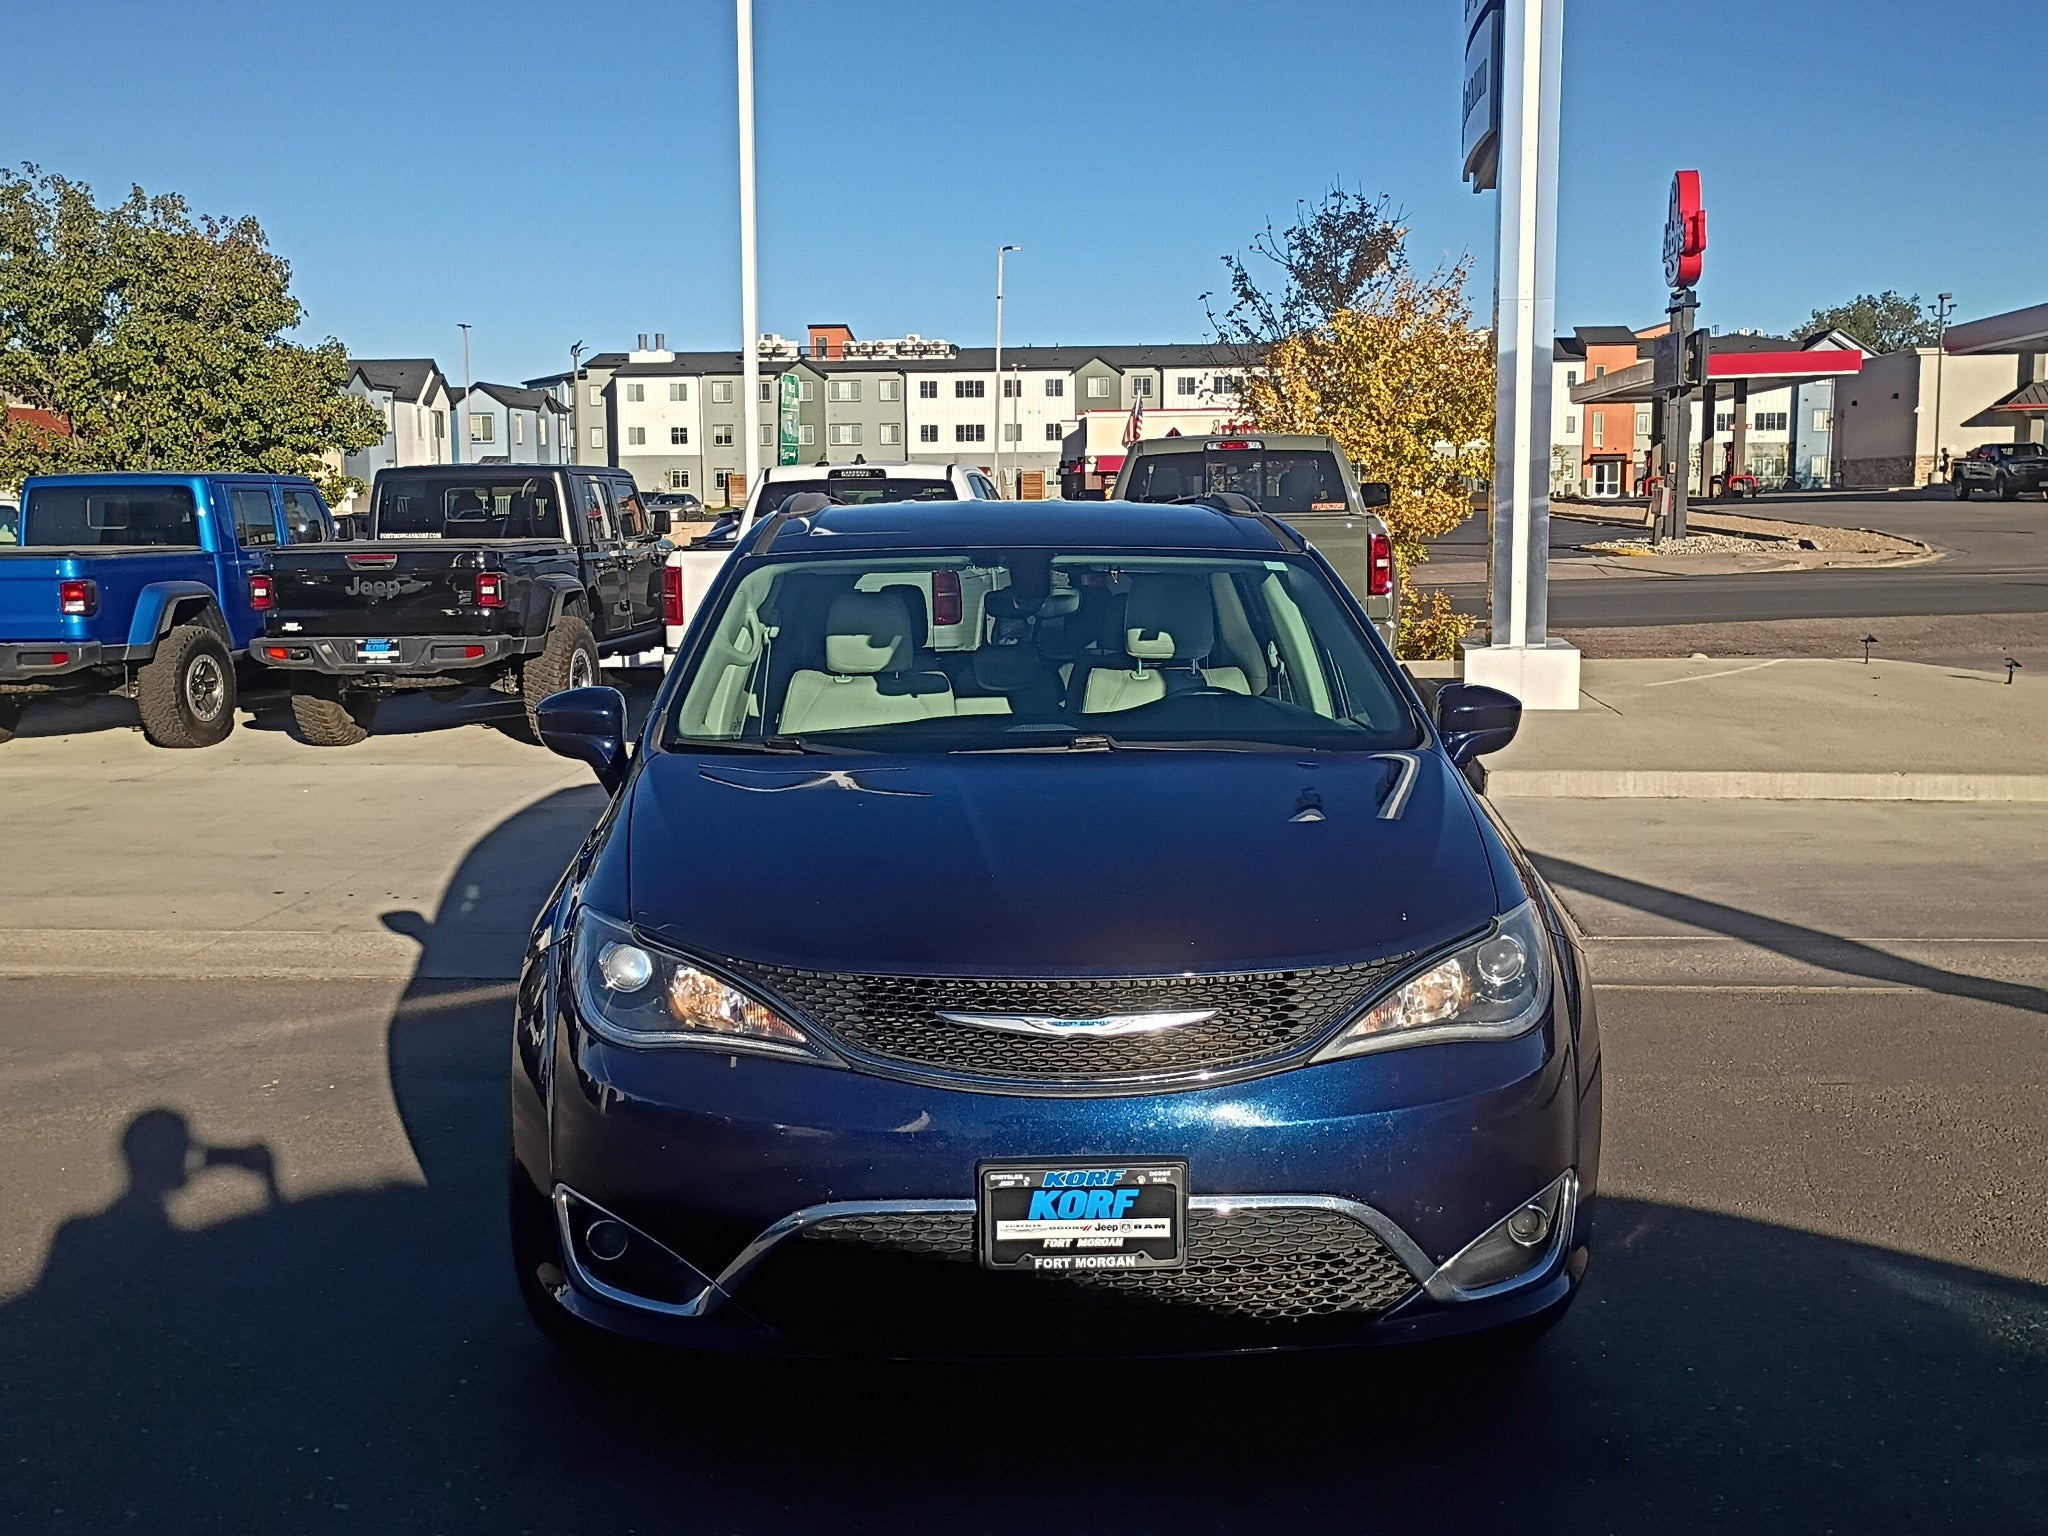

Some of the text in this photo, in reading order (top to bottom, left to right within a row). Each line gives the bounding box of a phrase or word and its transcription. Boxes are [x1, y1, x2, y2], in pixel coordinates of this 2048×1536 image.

[345, 576, 401, 601] Jeep
[1042, 1169, 1126, 1187] KORF
[1028, 1189, 1139, 1219] KORF
[1094, 1222, 1118, 1232] Jeep
[1043, 1237, 1124, 1248] FORT MORGAN
[1034, 1255, 1136, 1269] FORT MORGAN
